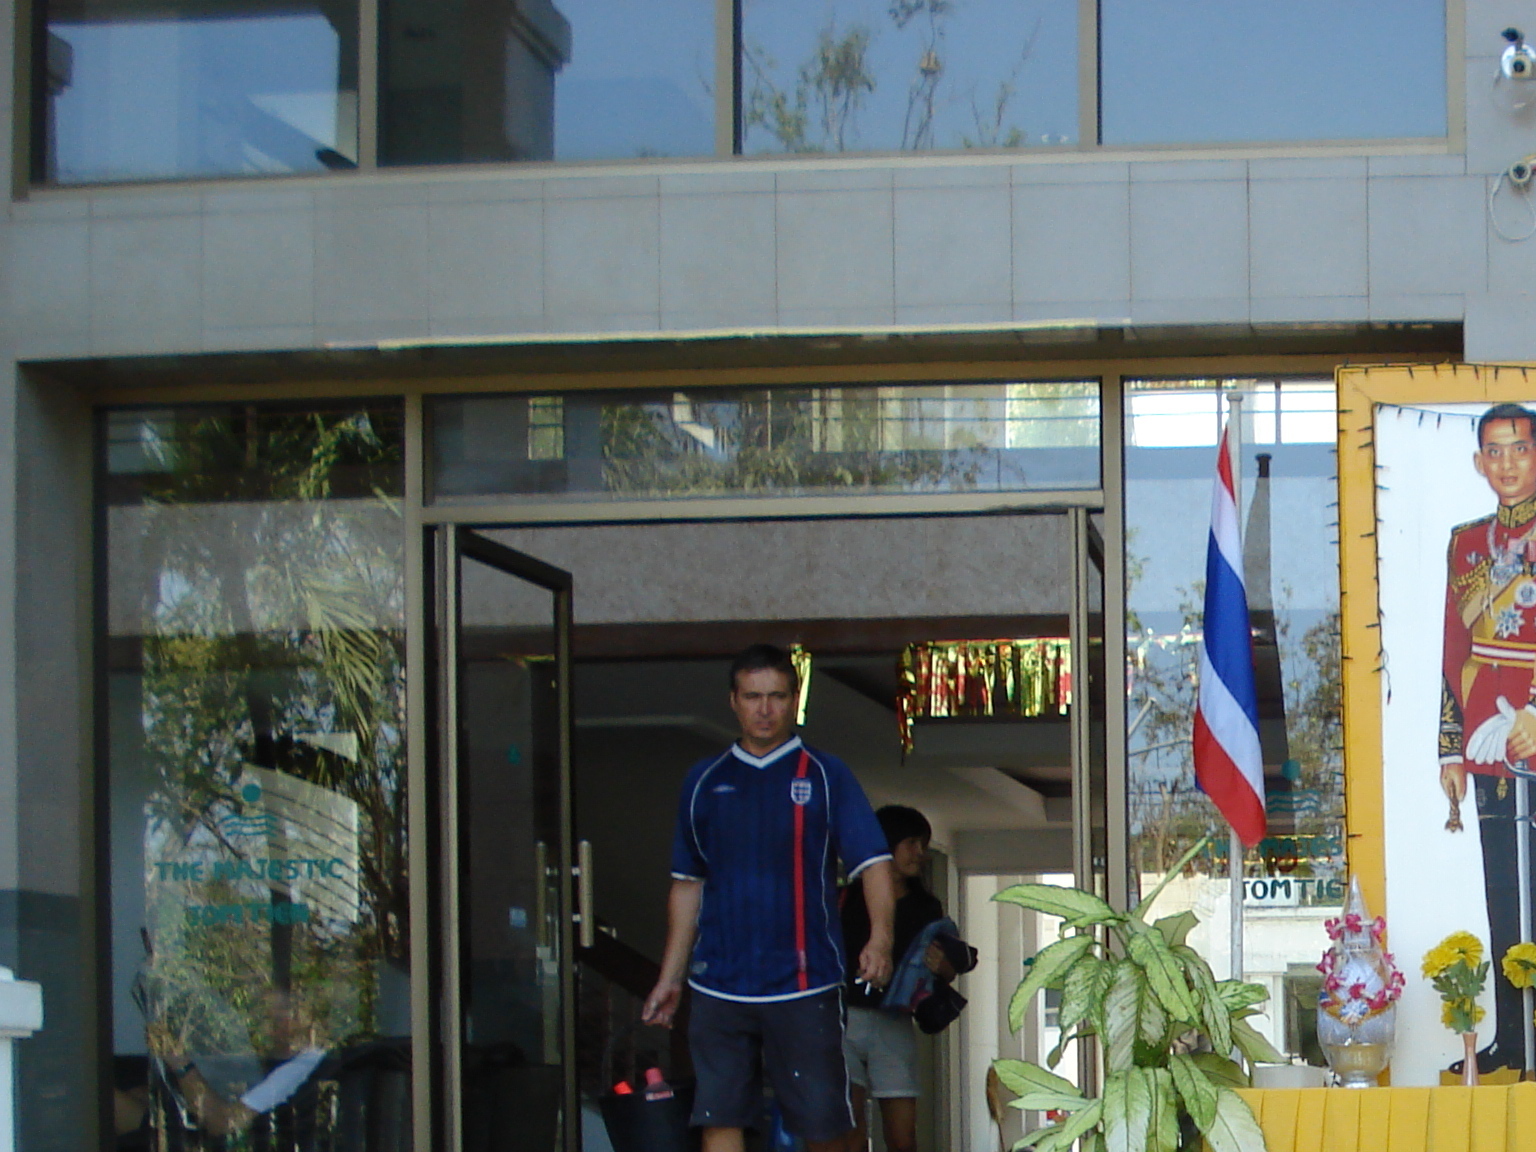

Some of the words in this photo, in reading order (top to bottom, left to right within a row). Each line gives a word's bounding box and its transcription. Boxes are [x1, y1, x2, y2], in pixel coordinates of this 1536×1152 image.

[1260, 836, 1344, 857] MAJES
[154, 861, 204, 881] THE
[213, 857, 345, 881] MAJESTIC
[1242, 878, 1344, 901] JOMTIE
